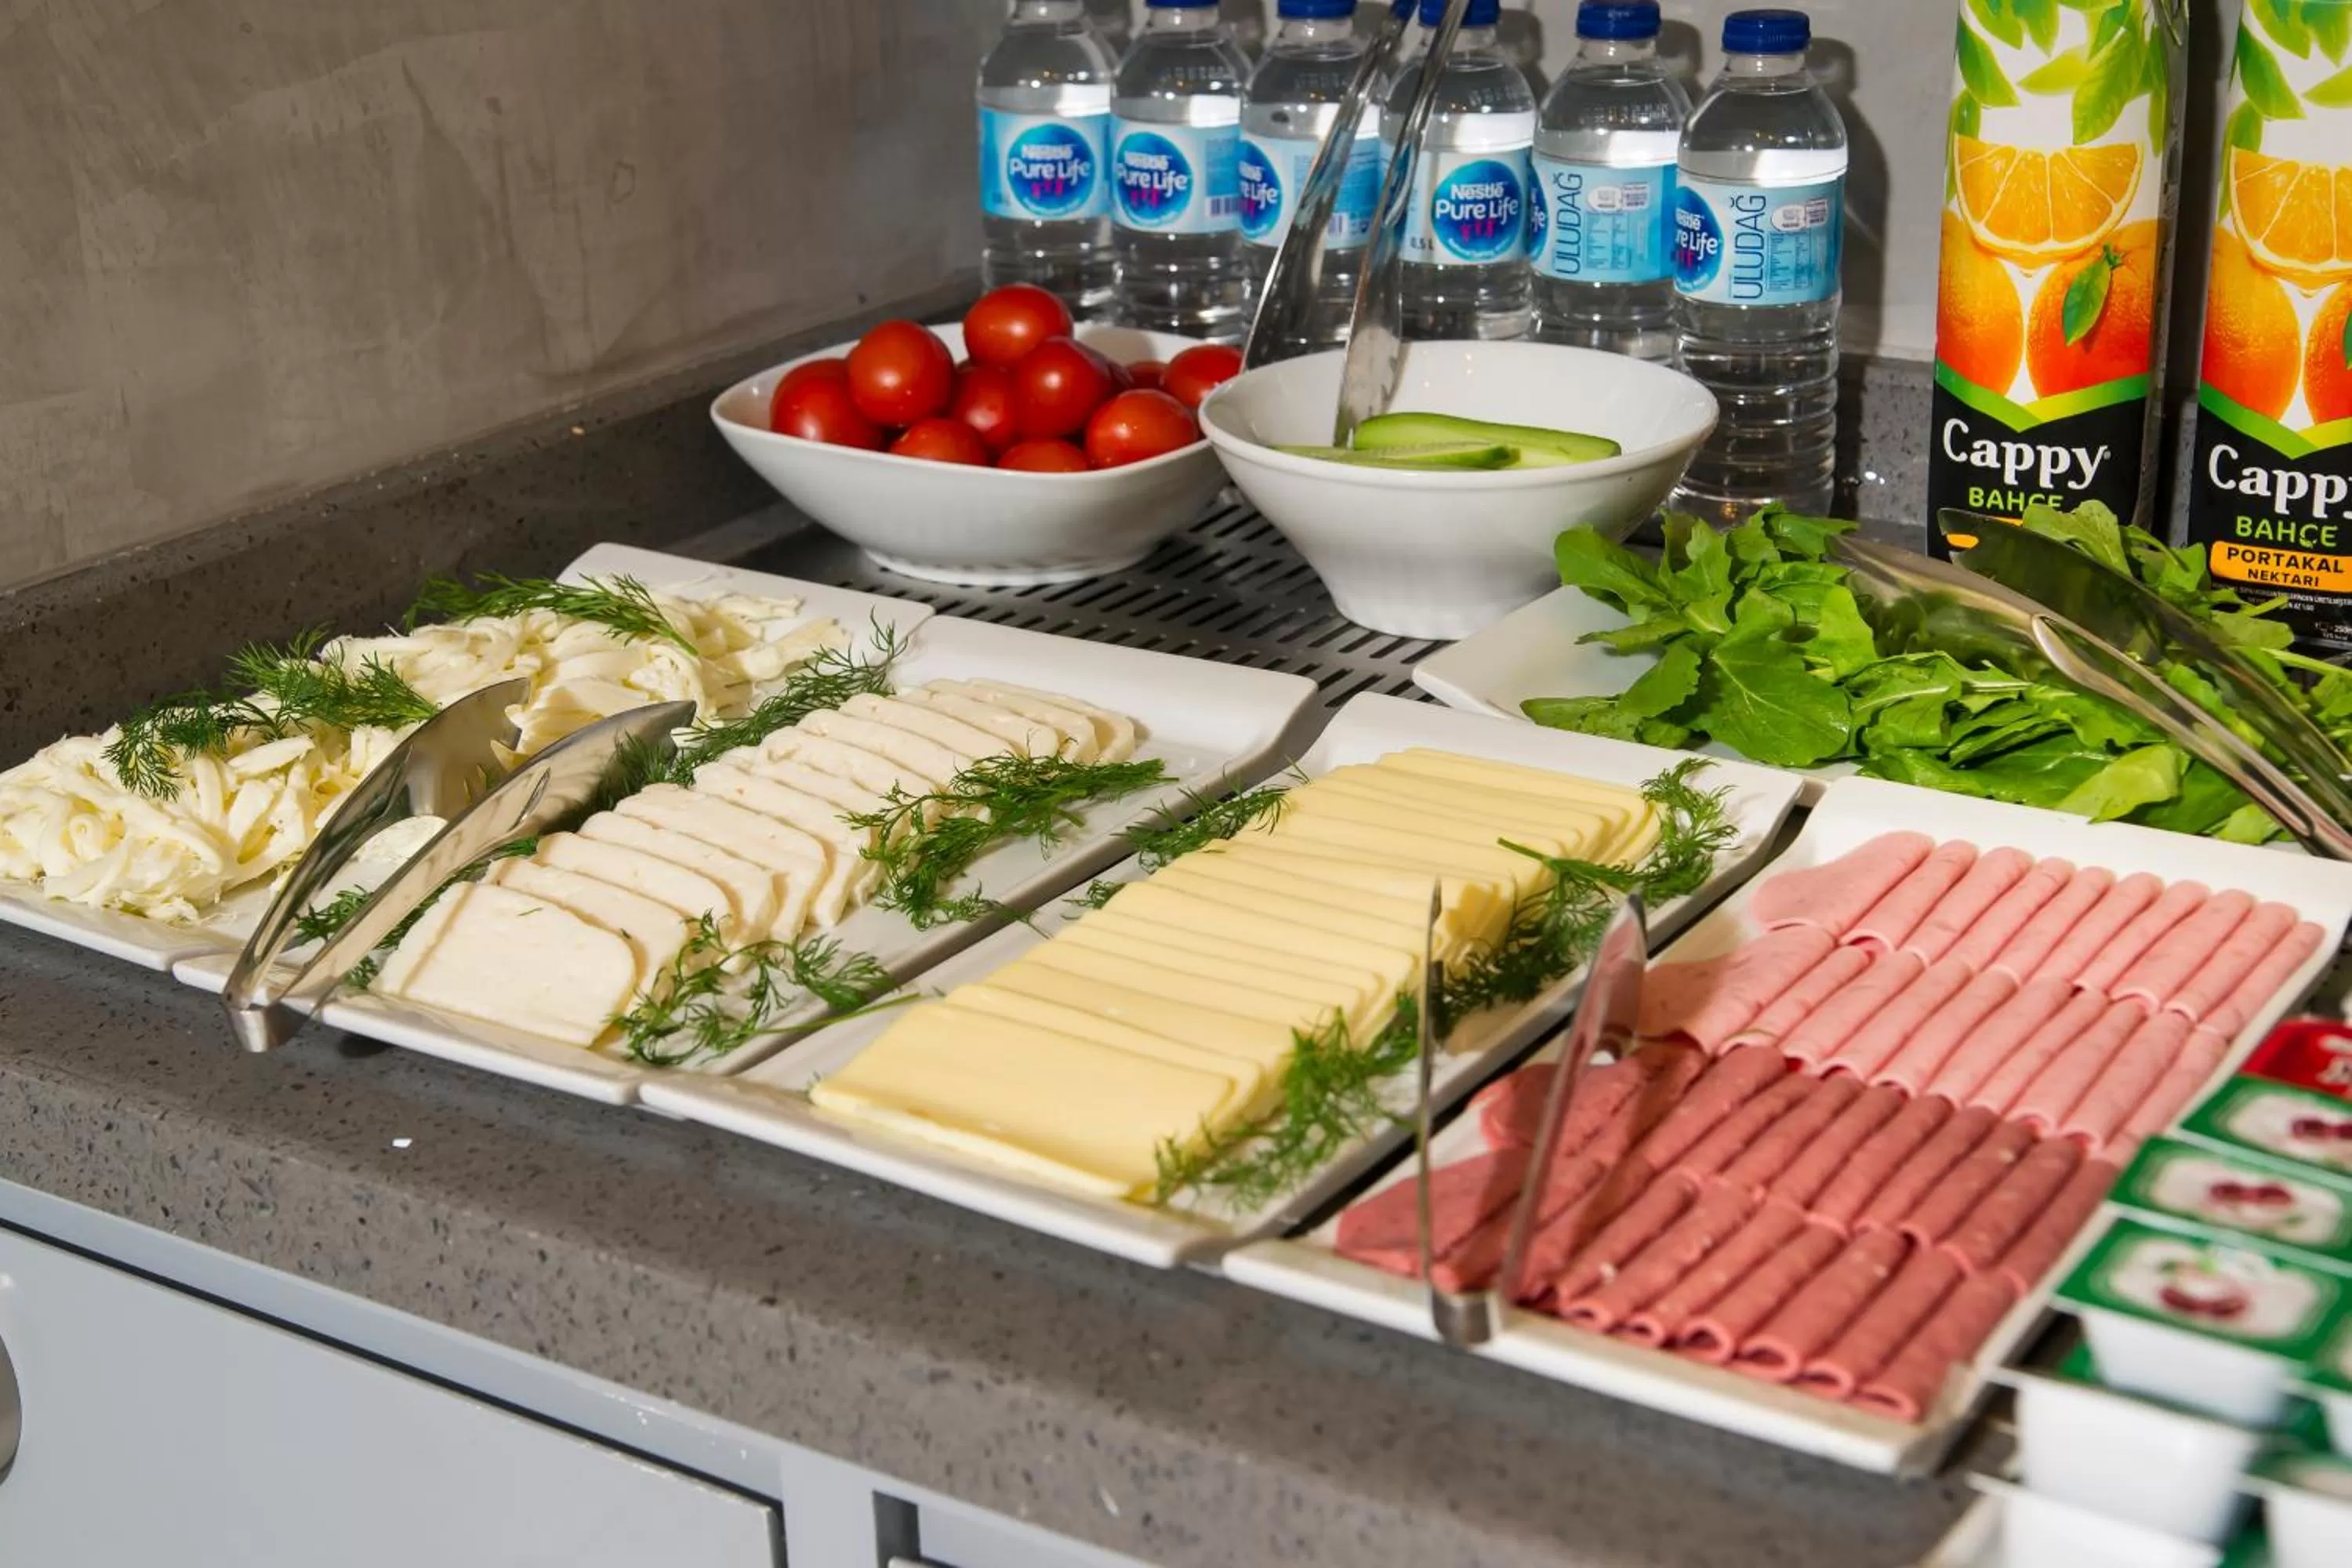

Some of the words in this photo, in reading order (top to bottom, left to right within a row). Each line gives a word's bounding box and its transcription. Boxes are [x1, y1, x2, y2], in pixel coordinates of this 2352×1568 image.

[1010, 158, 1055, 180] Pure
[1058, 158, 1091, 187] Life
[1153, 170, 1187, 198] Life
[1251, 182, 1278, 210] Life
[1436, 199, 1486, 220] Pure
[1490, 197, 1519, 226] Life
[1553, 172, 1583, 274] ULUDAĞ
[1690, 231, 1719, 261] Life
[1730, 194, 1767, 299] ULUDAĞ
[1943, 417, 2108, 490] Cappy
[2208, 444, 2352, 521] Capp
[2235, 515, 2339, 549] BAHÇE
[2227, 546, 2344, 574] PORTAKAL
[2247, 568, 2320, 587] NEKTARI
